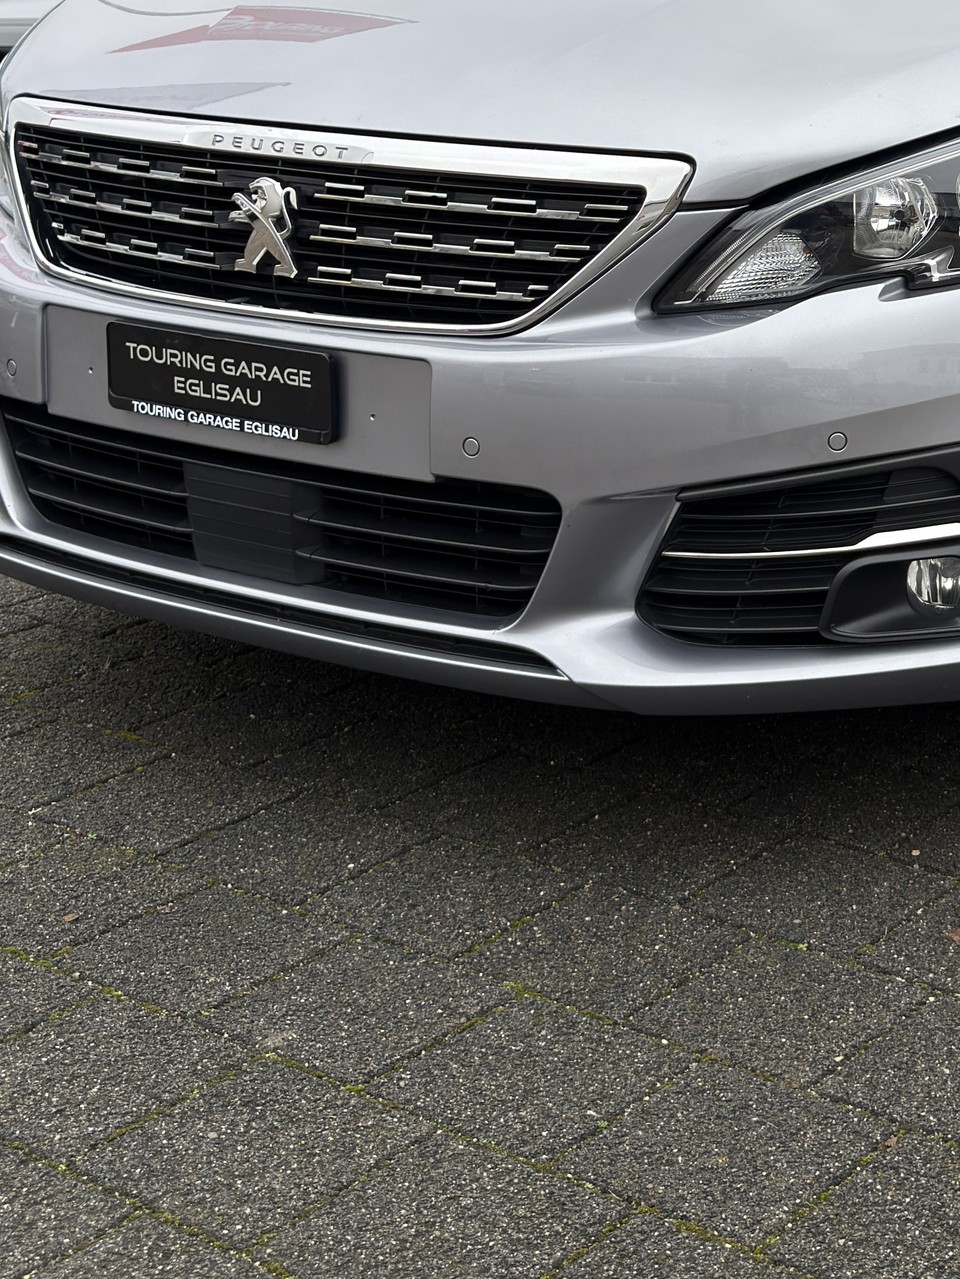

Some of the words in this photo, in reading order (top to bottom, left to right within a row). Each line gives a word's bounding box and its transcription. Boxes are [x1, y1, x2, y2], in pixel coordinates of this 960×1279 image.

[211, 133, 349, 161] PEUGEOT
[125, 341, 216, 374] TOURING
[220, 357, 312, 390] GARAGE
[173, 375, 262, 408] EGLISAU
[131, 400, 185, 422] TOURING
[187, 410, 241, 433] GARAGE
[243, 420, 300, 442] EGLISAU
